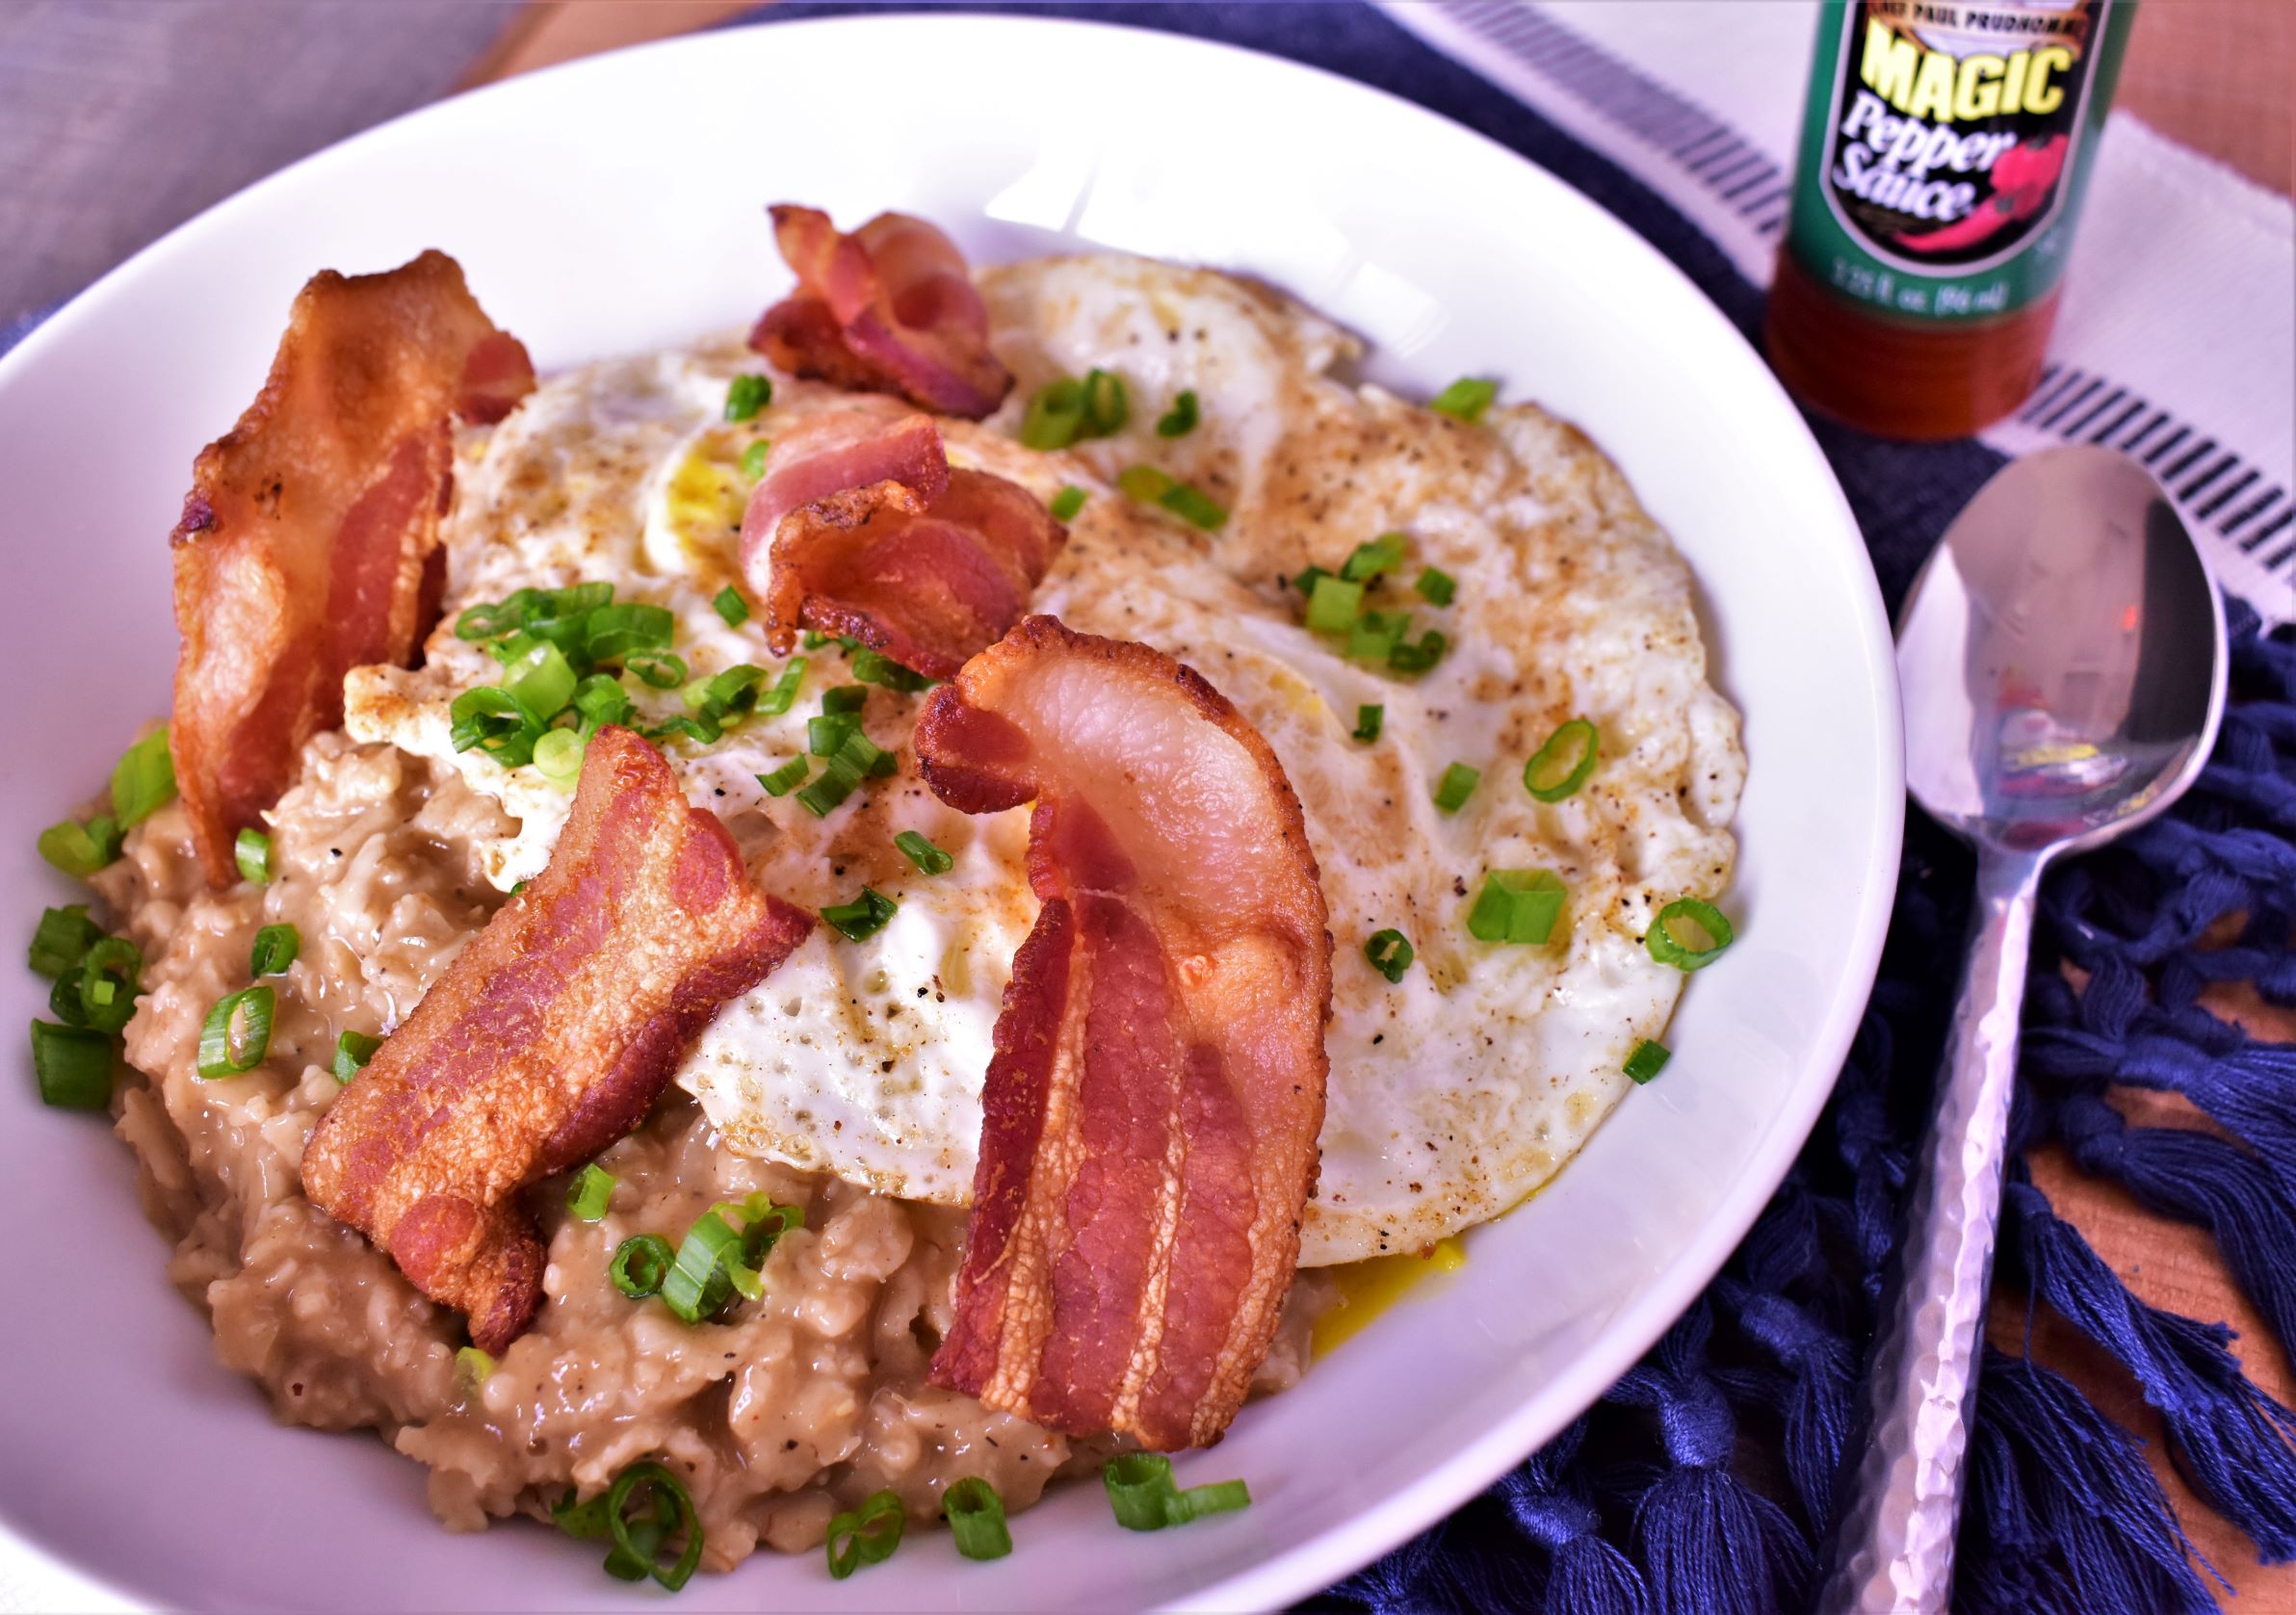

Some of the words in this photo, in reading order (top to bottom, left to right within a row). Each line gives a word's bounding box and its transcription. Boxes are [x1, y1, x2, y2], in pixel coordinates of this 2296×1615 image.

[1913, 3, 1956, 26] PAUL
[1860, 16, 2073, 123] MAGIC
[1840, 89, 2019, 178] Pepper
